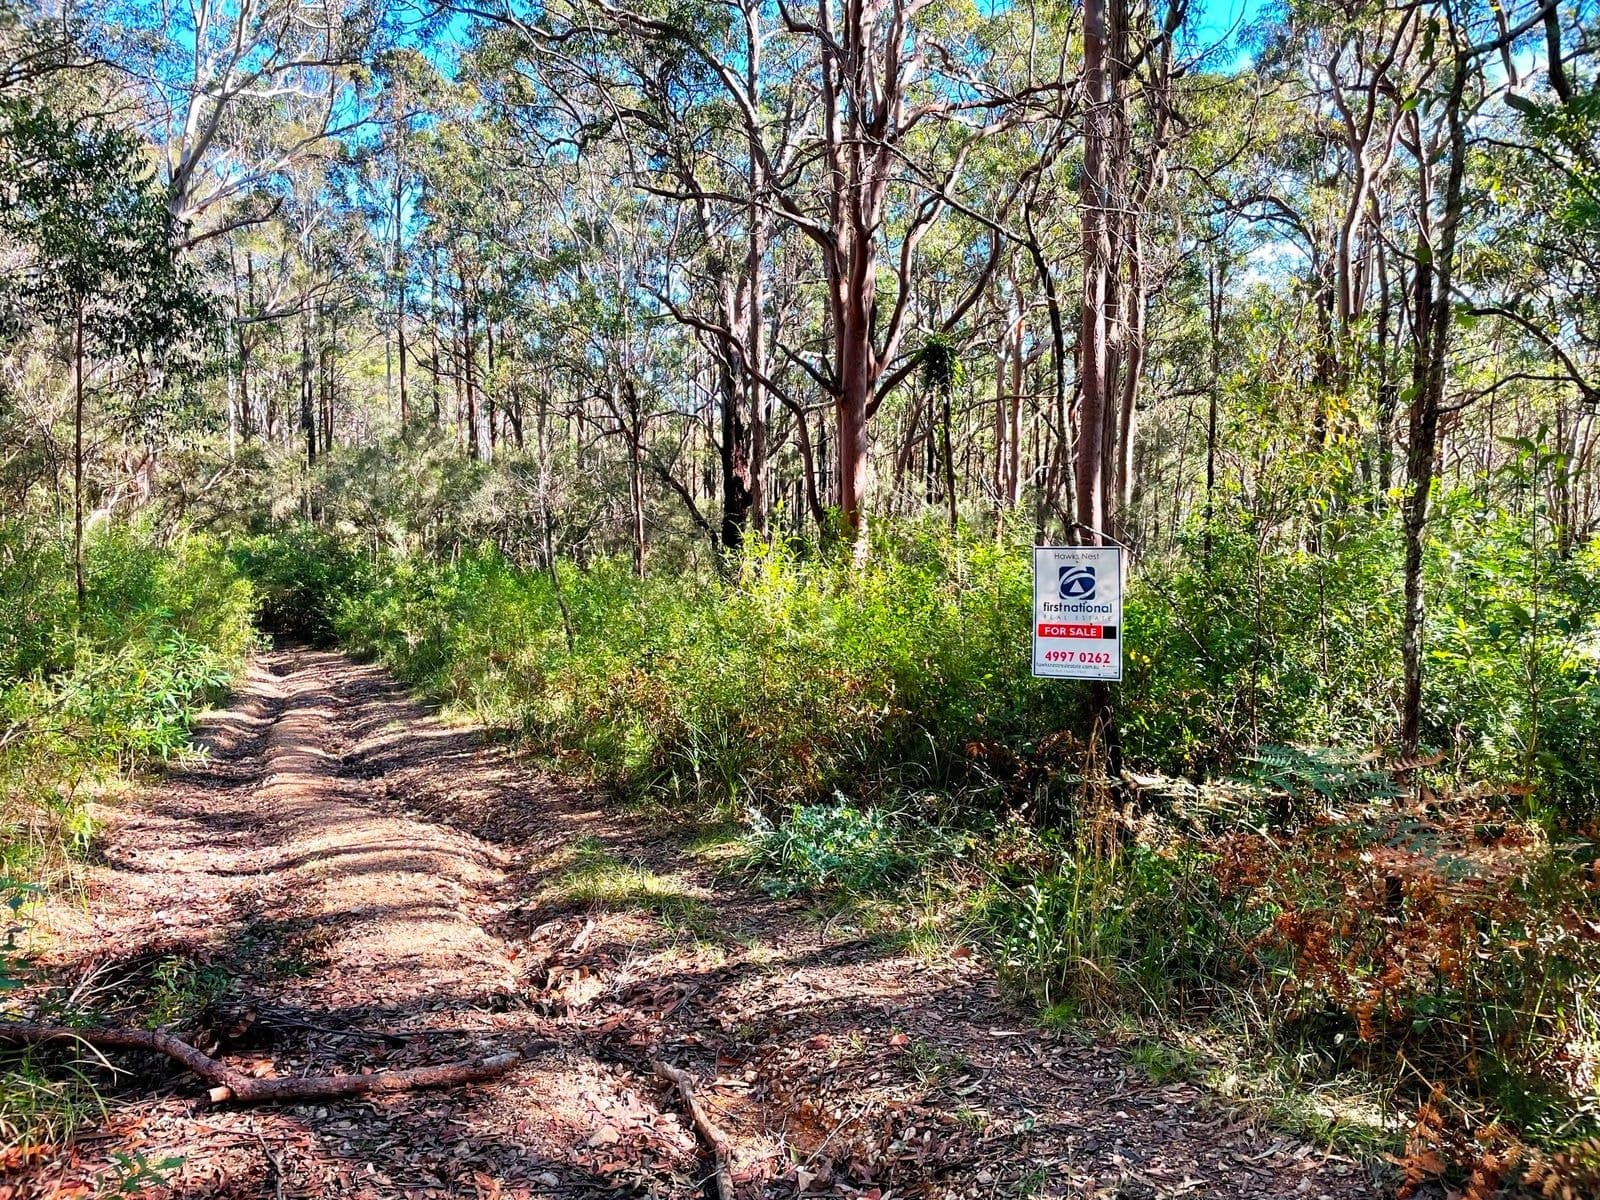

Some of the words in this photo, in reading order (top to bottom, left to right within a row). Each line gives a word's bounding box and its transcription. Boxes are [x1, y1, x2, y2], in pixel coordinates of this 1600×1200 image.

[1044, 626, 1067, 636] FOR
[1069, 627, 1097, 637] SALE
[1045, 651, 1075, 662] 4997
[1079, 652, 1111, 664] 0262
